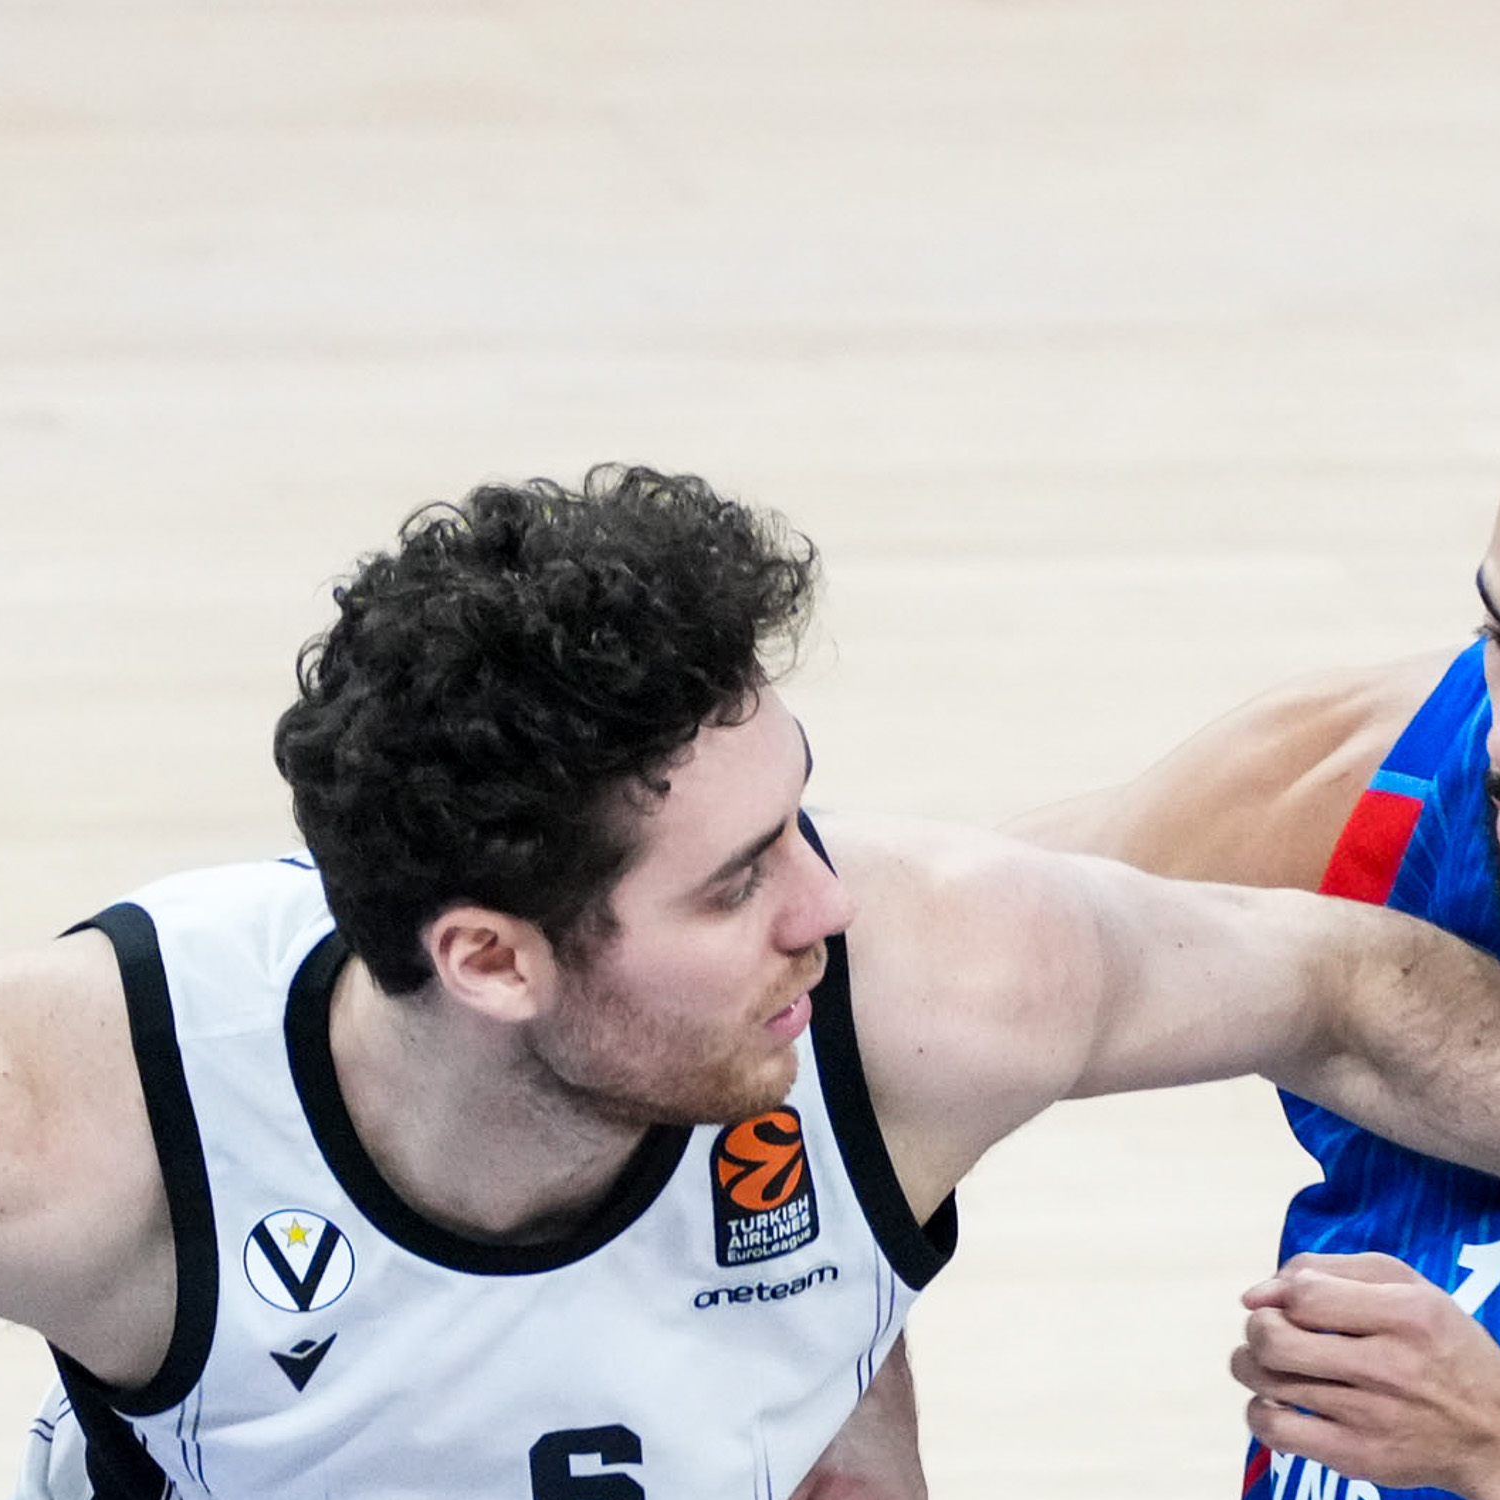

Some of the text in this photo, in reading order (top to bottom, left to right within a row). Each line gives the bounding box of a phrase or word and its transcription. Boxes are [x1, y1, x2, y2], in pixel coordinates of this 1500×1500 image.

[727, 1194, 809, 1235] TURKISH
[728, 1213, 810, 1249] AIRLINES
[727, 1227, 812, 1263] EuroLeague
[694, 1266, 839, 1309] oneteam
